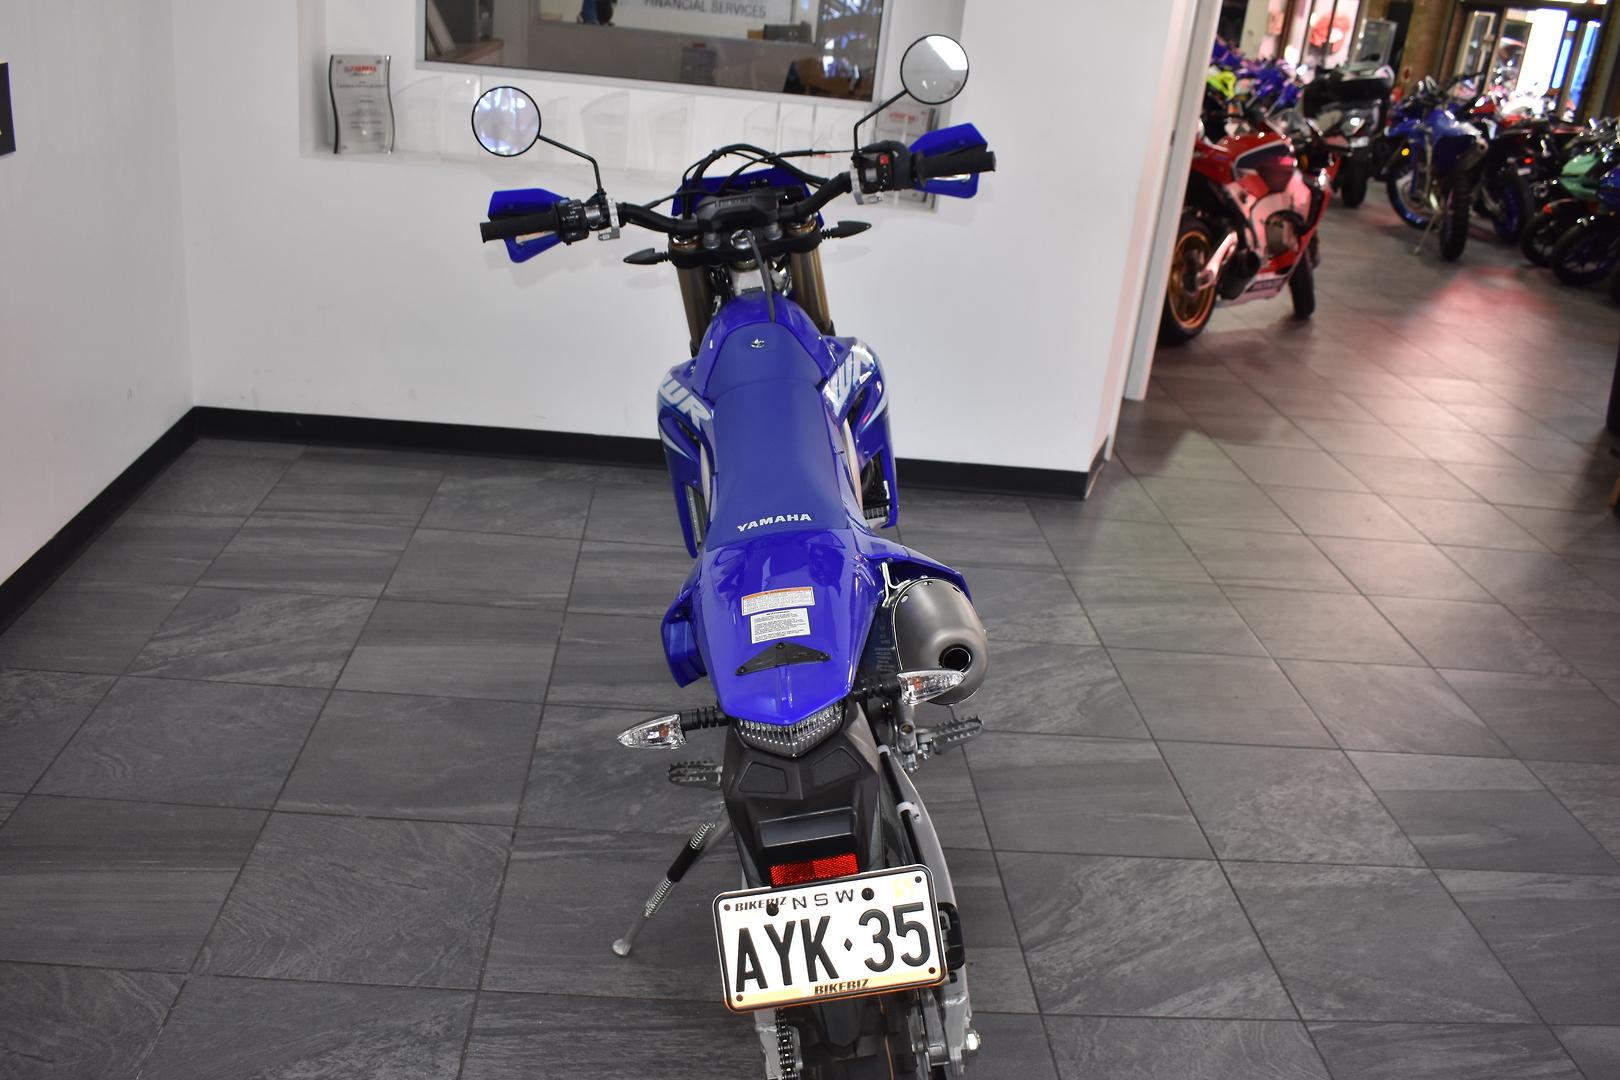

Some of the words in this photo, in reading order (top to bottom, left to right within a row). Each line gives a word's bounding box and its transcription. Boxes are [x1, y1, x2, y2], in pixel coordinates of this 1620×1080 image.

[711, 0, 766, 18] SERVICES
[737, 513, 812, 532] YAMAHA
[735, 897, 787, 912] BIKEBIZ
[814, 979, 869, 995] BIKEBIZ
